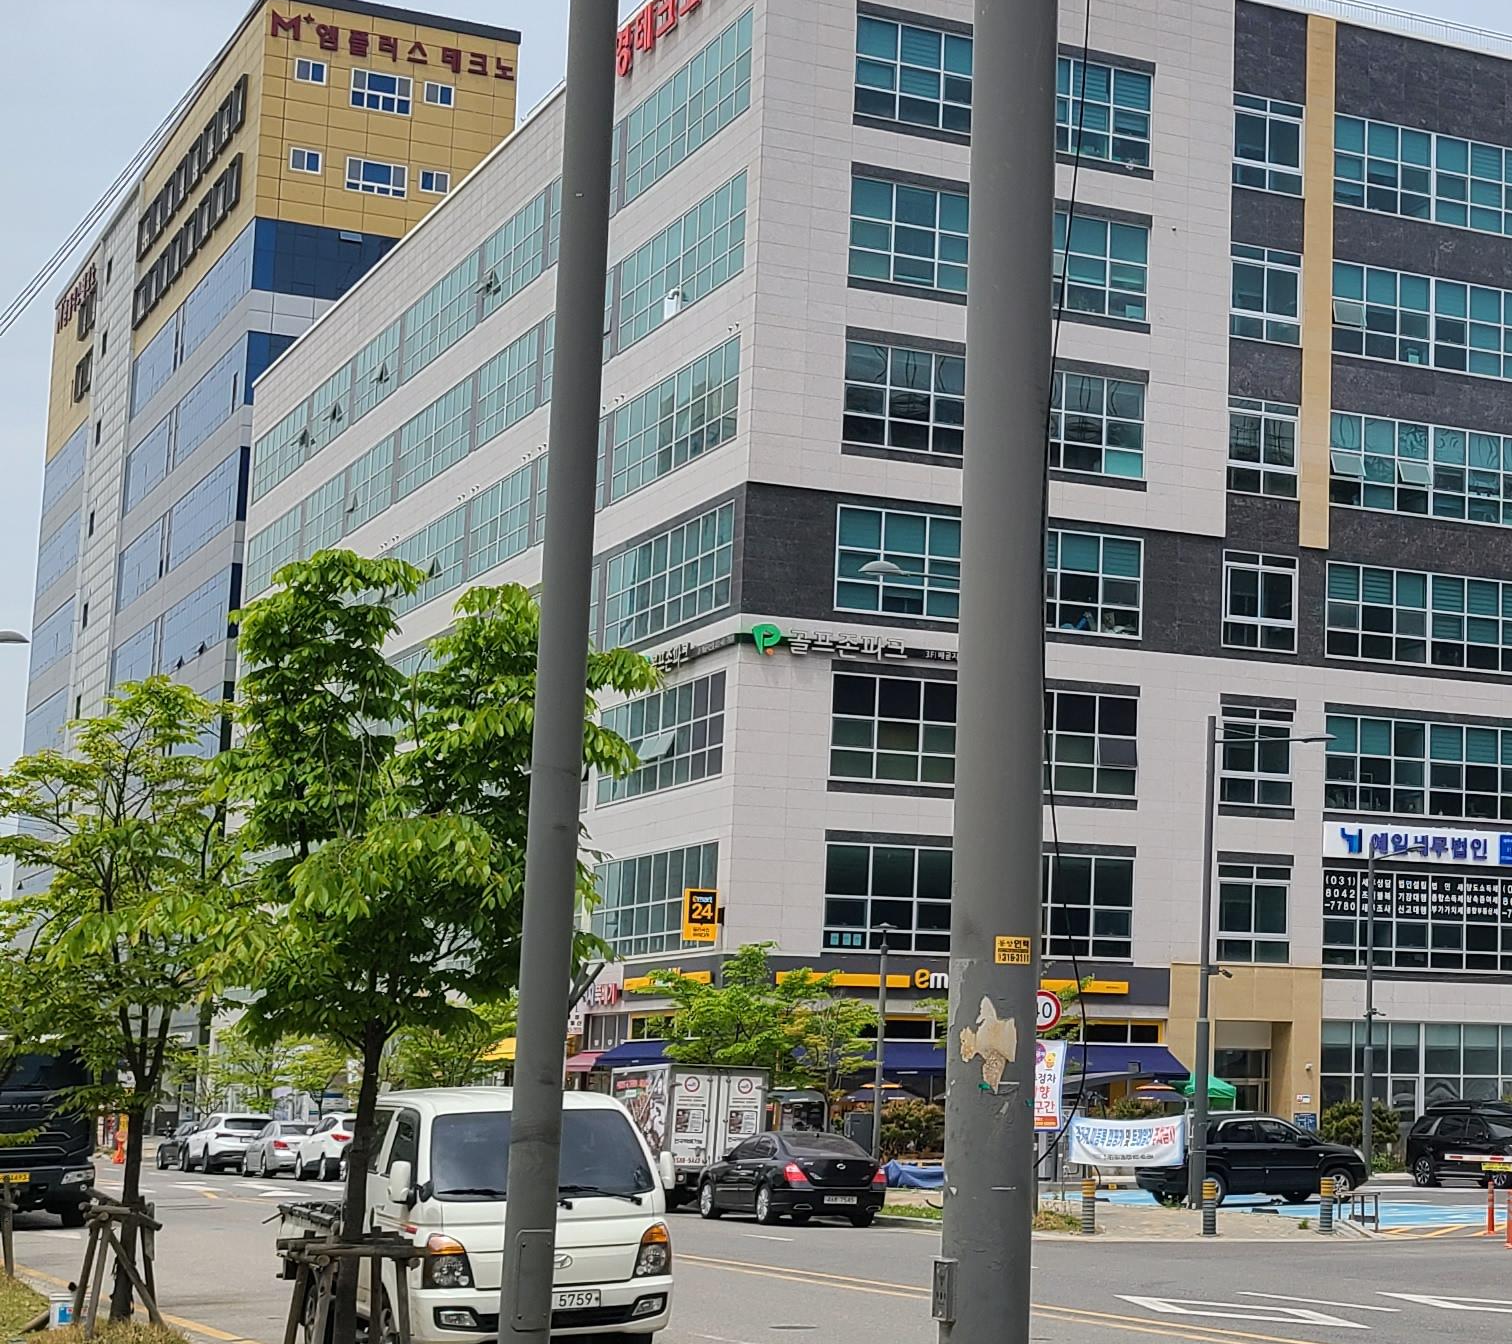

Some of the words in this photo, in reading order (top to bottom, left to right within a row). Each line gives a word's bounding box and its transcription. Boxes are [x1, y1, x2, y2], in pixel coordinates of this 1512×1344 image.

[787, 628, 908, 663] 골프존파크
[1370, 831, 1488, 862] 예일세무법인
[1325, 875, 1356, 886] (031)
[1325, 888, 1356, 899] 8042
[691, 902, 714, 920] 24
[558, 1292, 593, 1308] 5759
